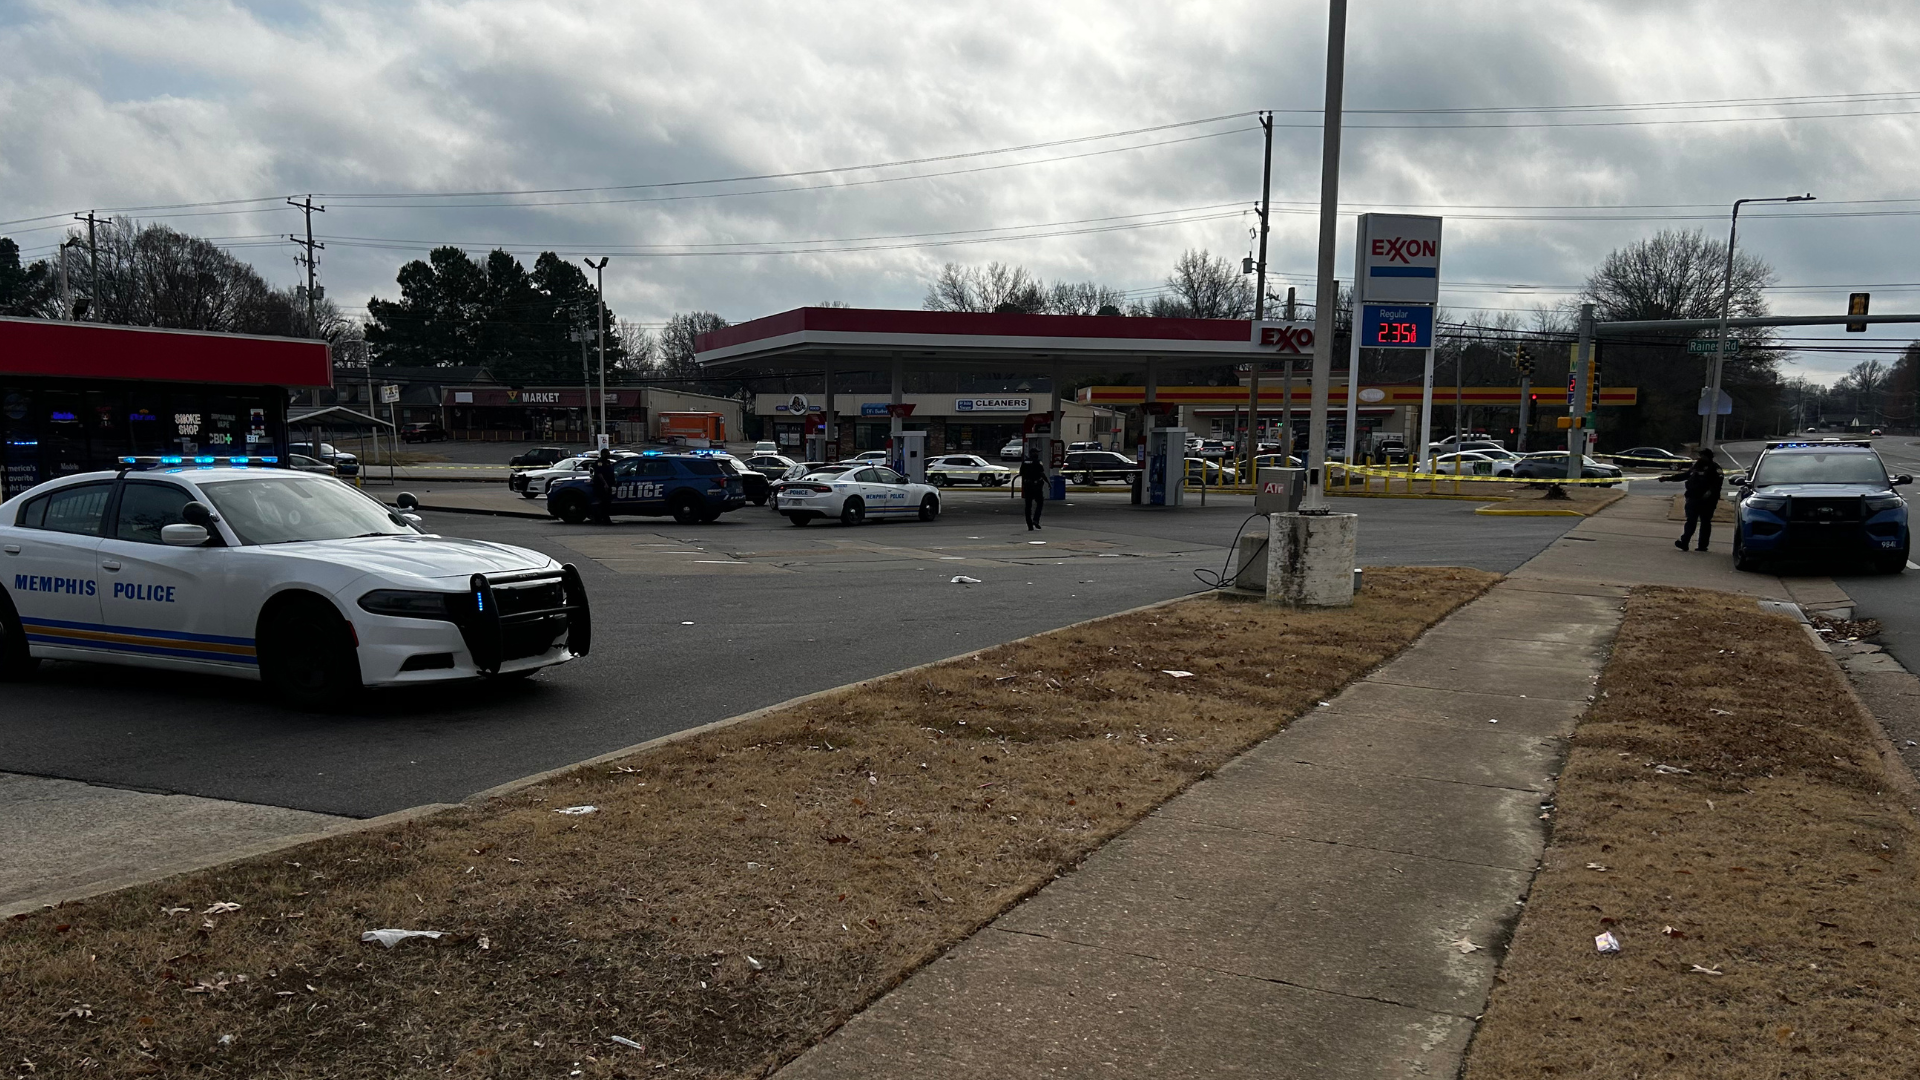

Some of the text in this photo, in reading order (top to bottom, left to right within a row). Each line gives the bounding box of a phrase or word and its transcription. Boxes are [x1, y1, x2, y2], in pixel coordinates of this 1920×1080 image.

[1372, 237, 1436, 264] EXXON
[1380, 309, 1409, 320] Regular
[1261, 326, 1315, 354] EXXO
[1724, 340, 1737, 351] Rd
[522, 392, 560, 403] MARKET
[174, 413, 202, 425] SMOKE
[178, 424, 199, 436] SHOP
[246, 434, 260, 443] EBT
[1265, 482, 1284, 494] Air
[14, 574, 176, 603] MEMPHIS POLICE
